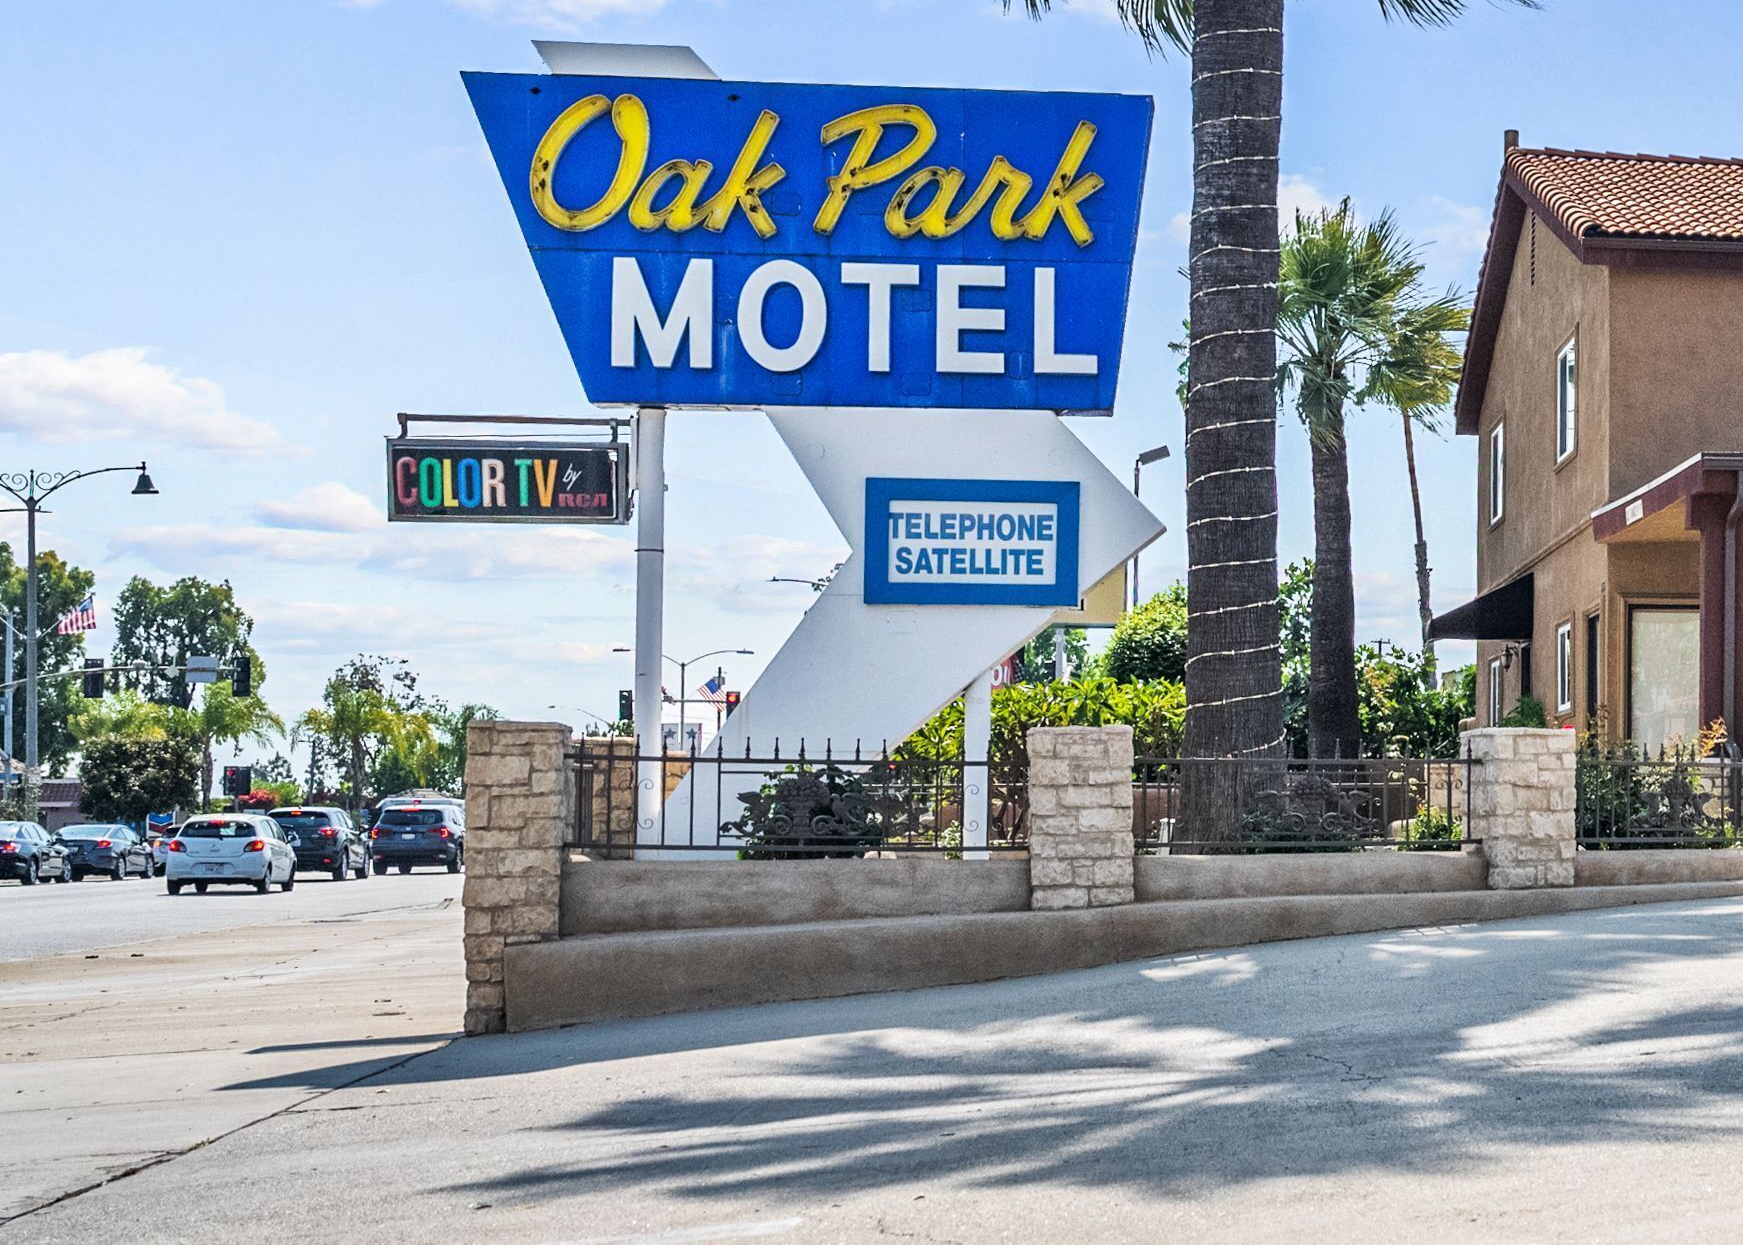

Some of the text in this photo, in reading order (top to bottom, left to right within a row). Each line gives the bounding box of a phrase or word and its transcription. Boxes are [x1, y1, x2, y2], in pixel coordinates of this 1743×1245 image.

[529, 93, 1106, 248] Oak Park
[610, 256, 1099, 375] MOTEL
[396, 456, 582, 508] COLOR TV by
[558, 493, 608, 508] RCA
[889, 512, 1054, 542] TELEPHONE
[895, 546, 1044, 576] SATELLITE
